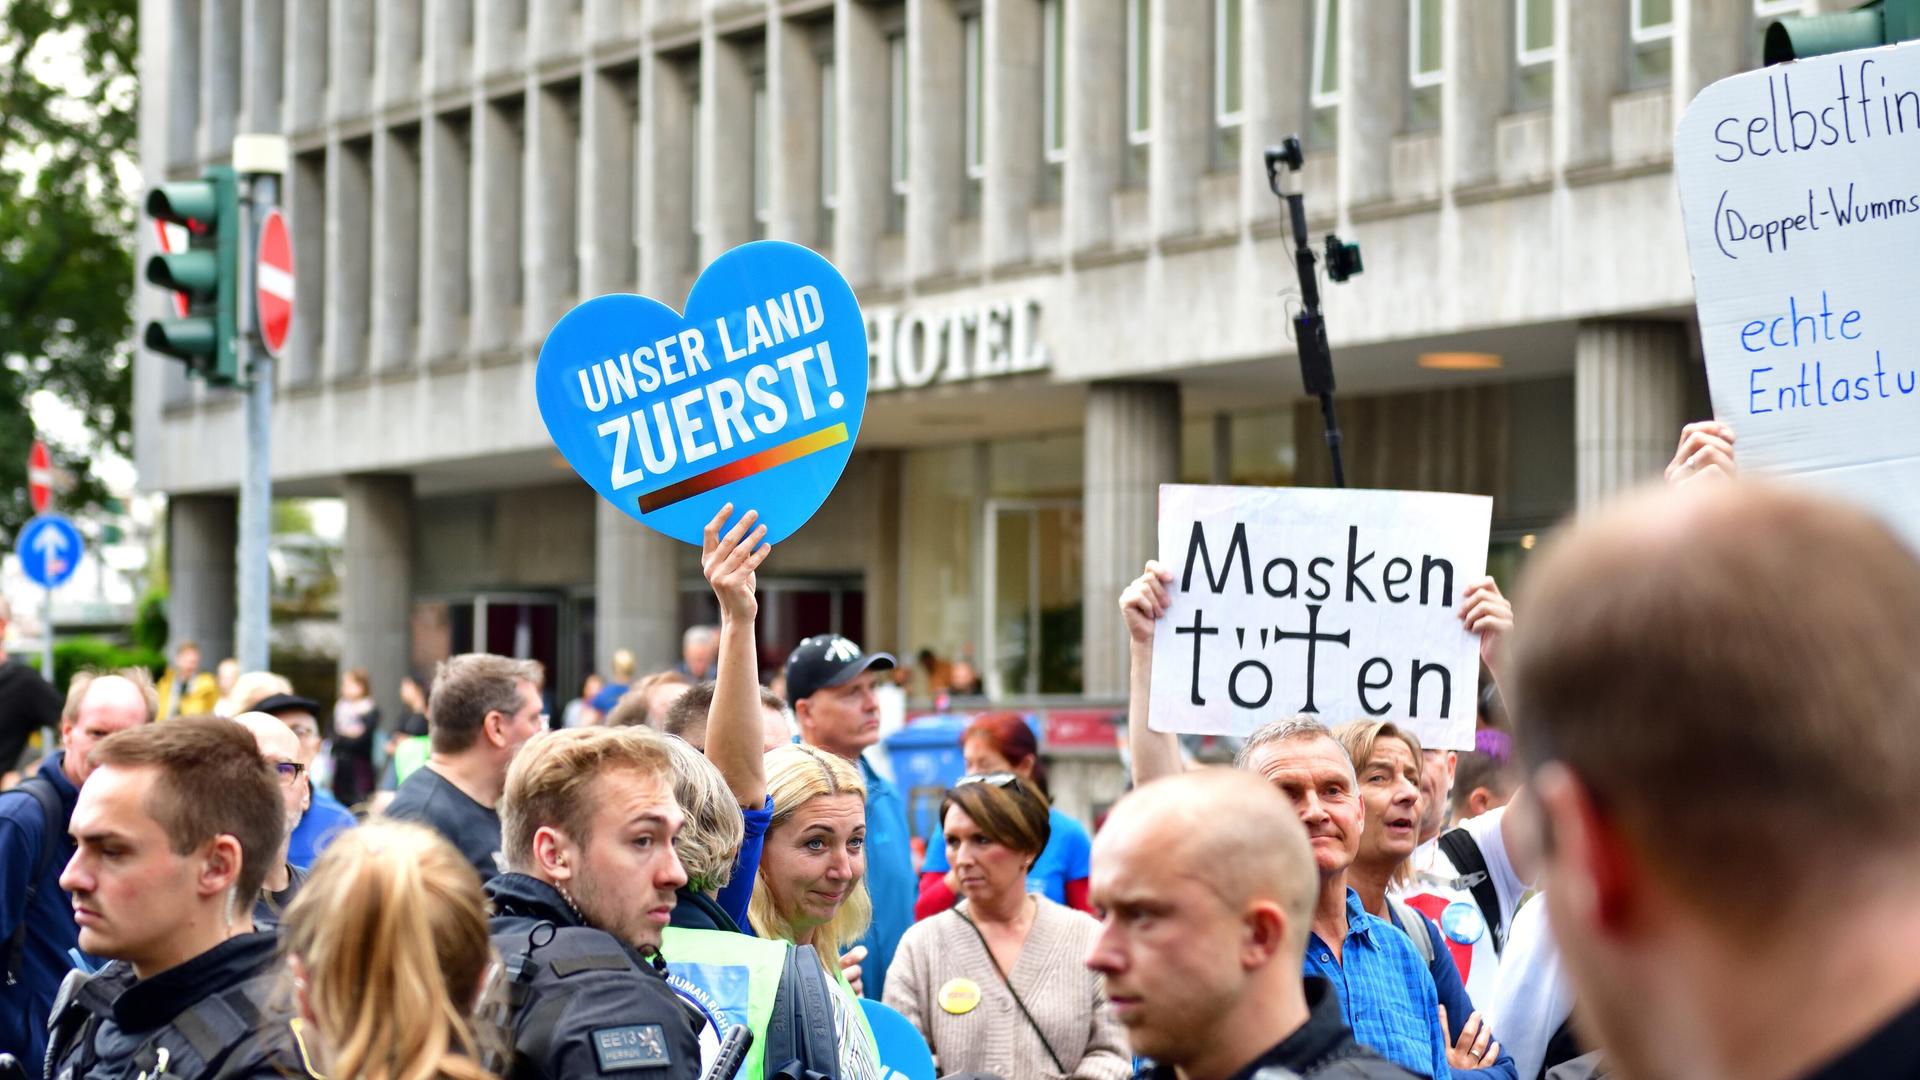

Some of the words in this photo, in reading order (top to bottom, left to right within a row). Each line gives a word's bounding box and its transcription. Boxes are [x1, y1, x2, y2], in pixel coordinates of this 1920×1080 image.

[1714, 59, 1920, 163] selbstfin
[1714, 182, 1920, 260] (Doppel-Wumms
[578, 328, 711, 412] UNSER
[717, 285, 825, 363] LAND
[864, 299, 1049, 391] HOTEL
[1741, 291, 1862, 353] echte
[597, 341, 845, 490] ZUERST!
[1749, 350, 1915, 416] Entlastu
[1181, 521, 1454, 607] Masken
[666, 974, 710, 1003] HUMAN
